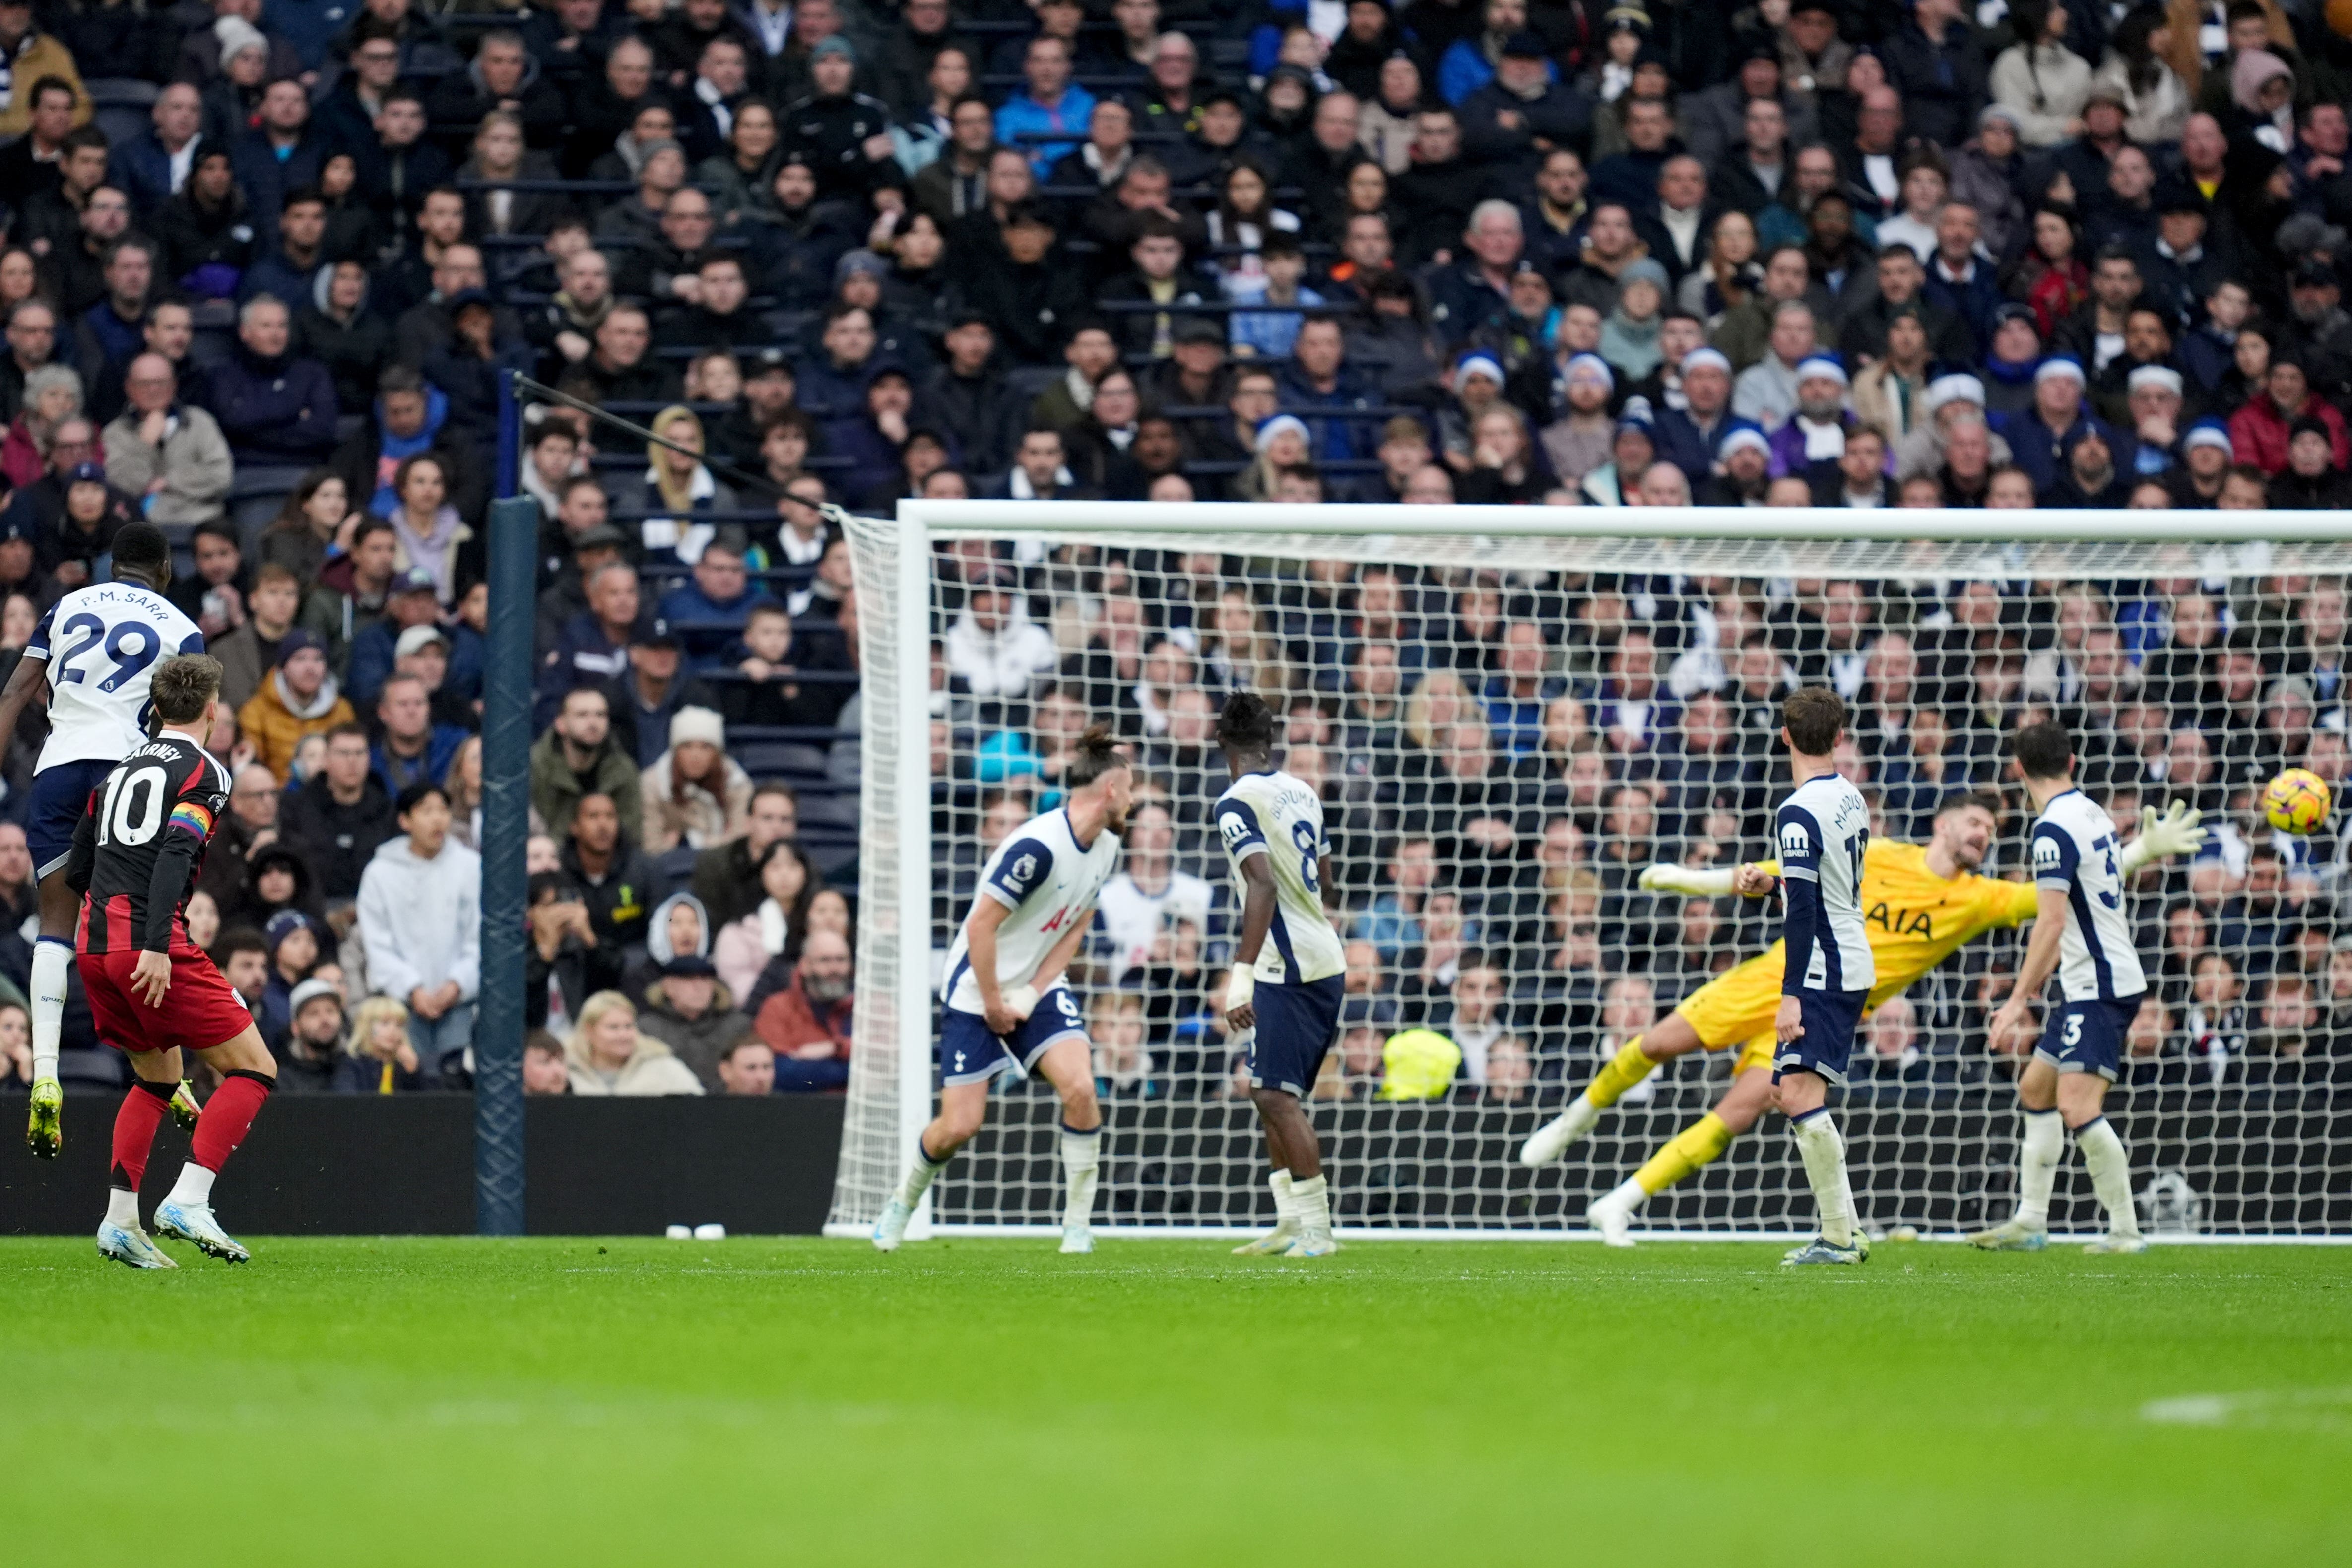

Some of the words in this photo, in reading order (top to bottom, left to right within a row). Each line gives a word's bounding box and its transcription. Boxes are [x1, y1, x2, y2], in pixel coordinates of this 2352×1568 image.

[125, 593, 169, 620] SARR
[55, 612, 161, 693] 29
[121, 743, 182, 764] CAIRNEY
[97, 766, 167, 846] 10
[1834, 794, 1867, 830] MADDIS
[1292, 820, 1319, 892] 8
[1865, 902, 1934, 941] AIA
[1056, 991, 1078, 1017] 6
